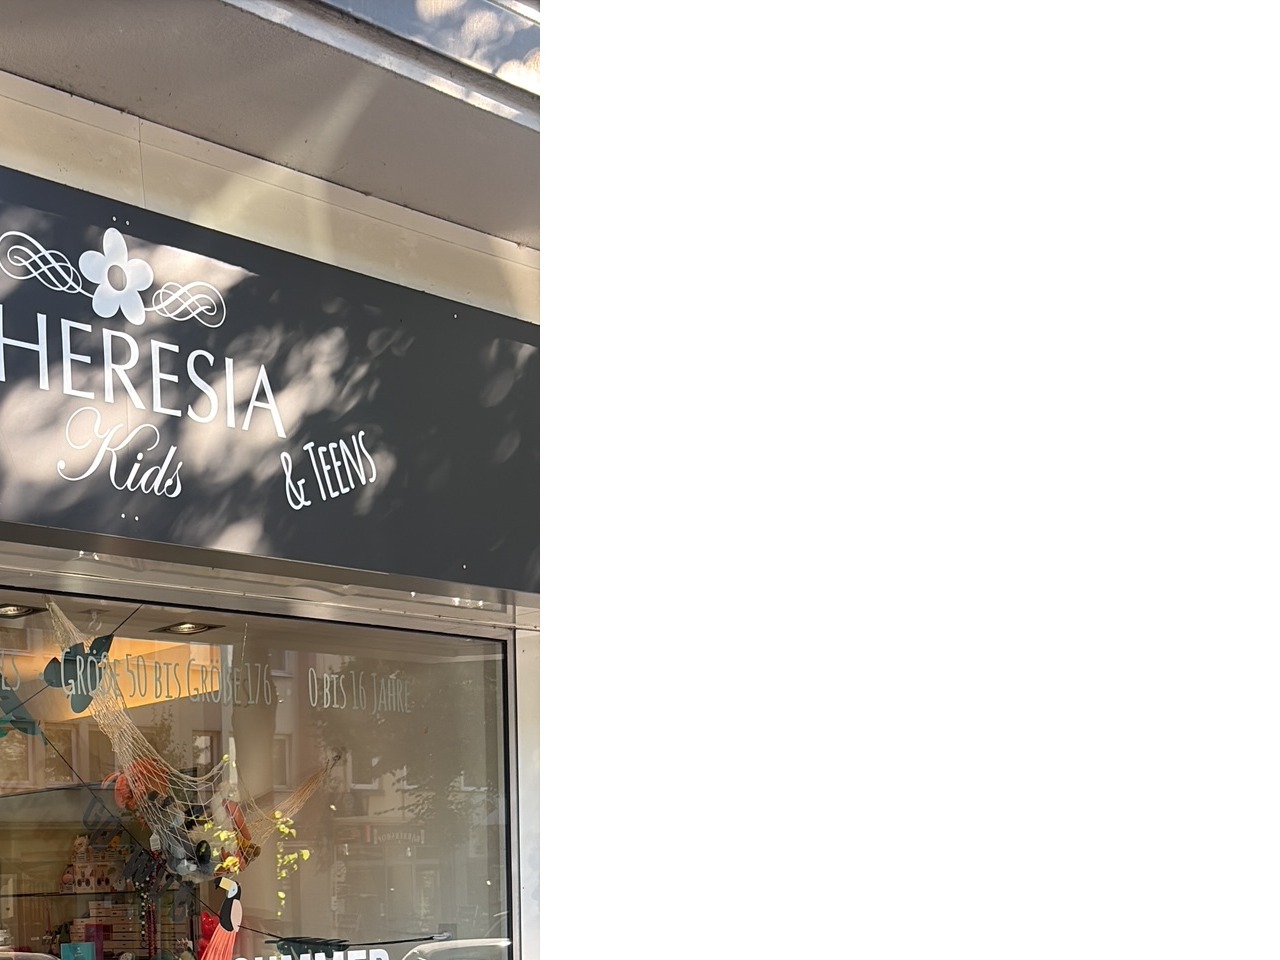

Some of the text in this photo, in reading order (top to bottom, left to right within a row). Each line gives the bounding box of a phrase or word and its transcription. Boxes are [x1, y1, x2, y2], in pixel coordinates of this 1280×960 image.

[56, 406, 184, 498] Kids
[280, 430, 377, 511] & TEENS
[125, 653, 147, 698] 50
[154, 661, 182, 699] BIS
[244, 663, 272, 706] 176
[308, 667, 413, 715] 0 BIS 16 JAHRE
